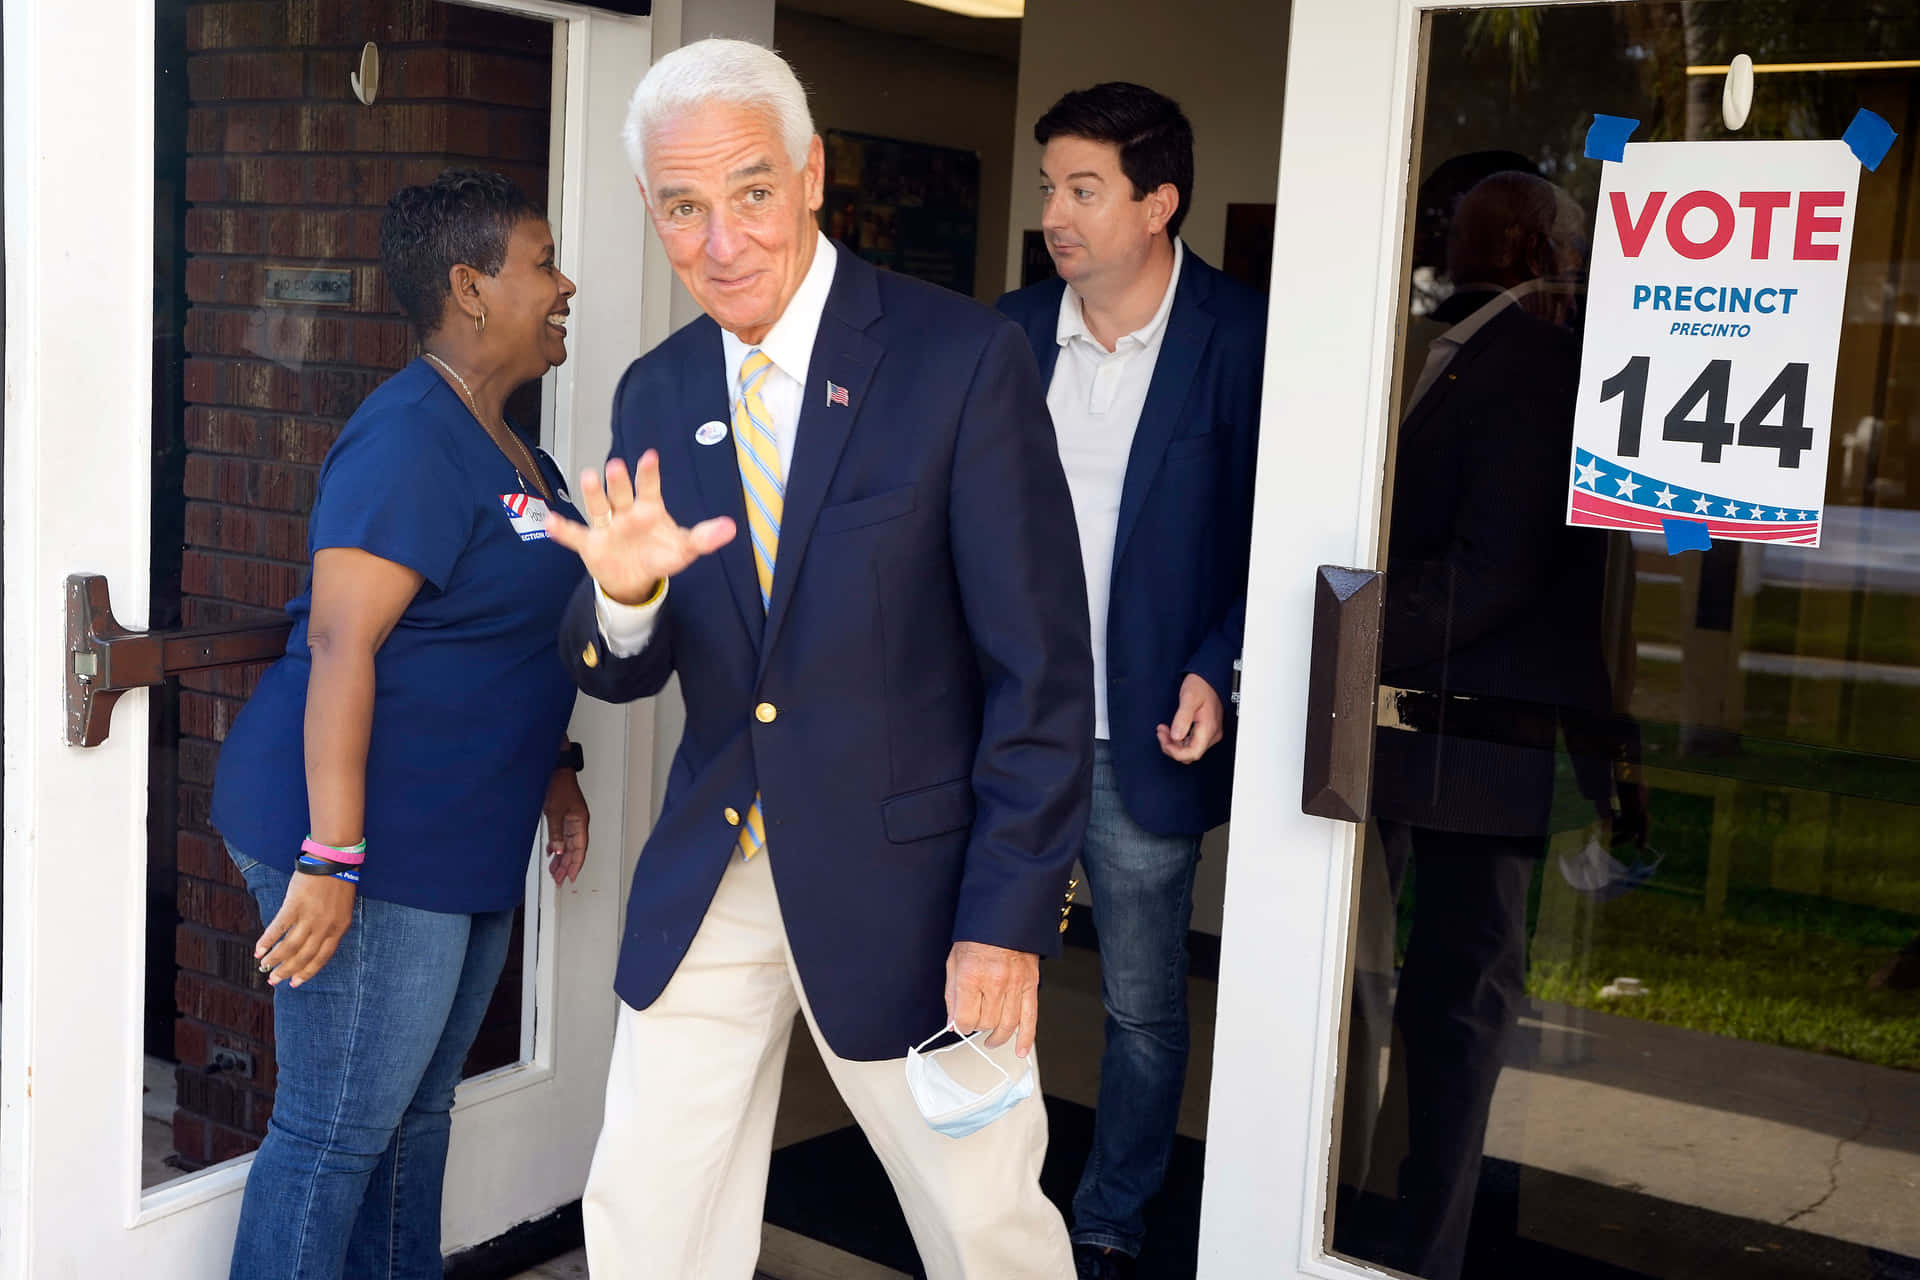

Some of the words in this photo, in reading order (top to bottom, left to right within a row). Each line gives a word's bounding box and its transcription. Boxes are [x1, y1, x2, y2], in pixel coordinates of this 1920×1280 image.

[1609, 190, 1845, 260] VOTE
[1633, 285, 1798, 314] PRECINCT
[1670, 322, 1751, 337] PRECINTO
[1600, 356, 1814, 469] 144
